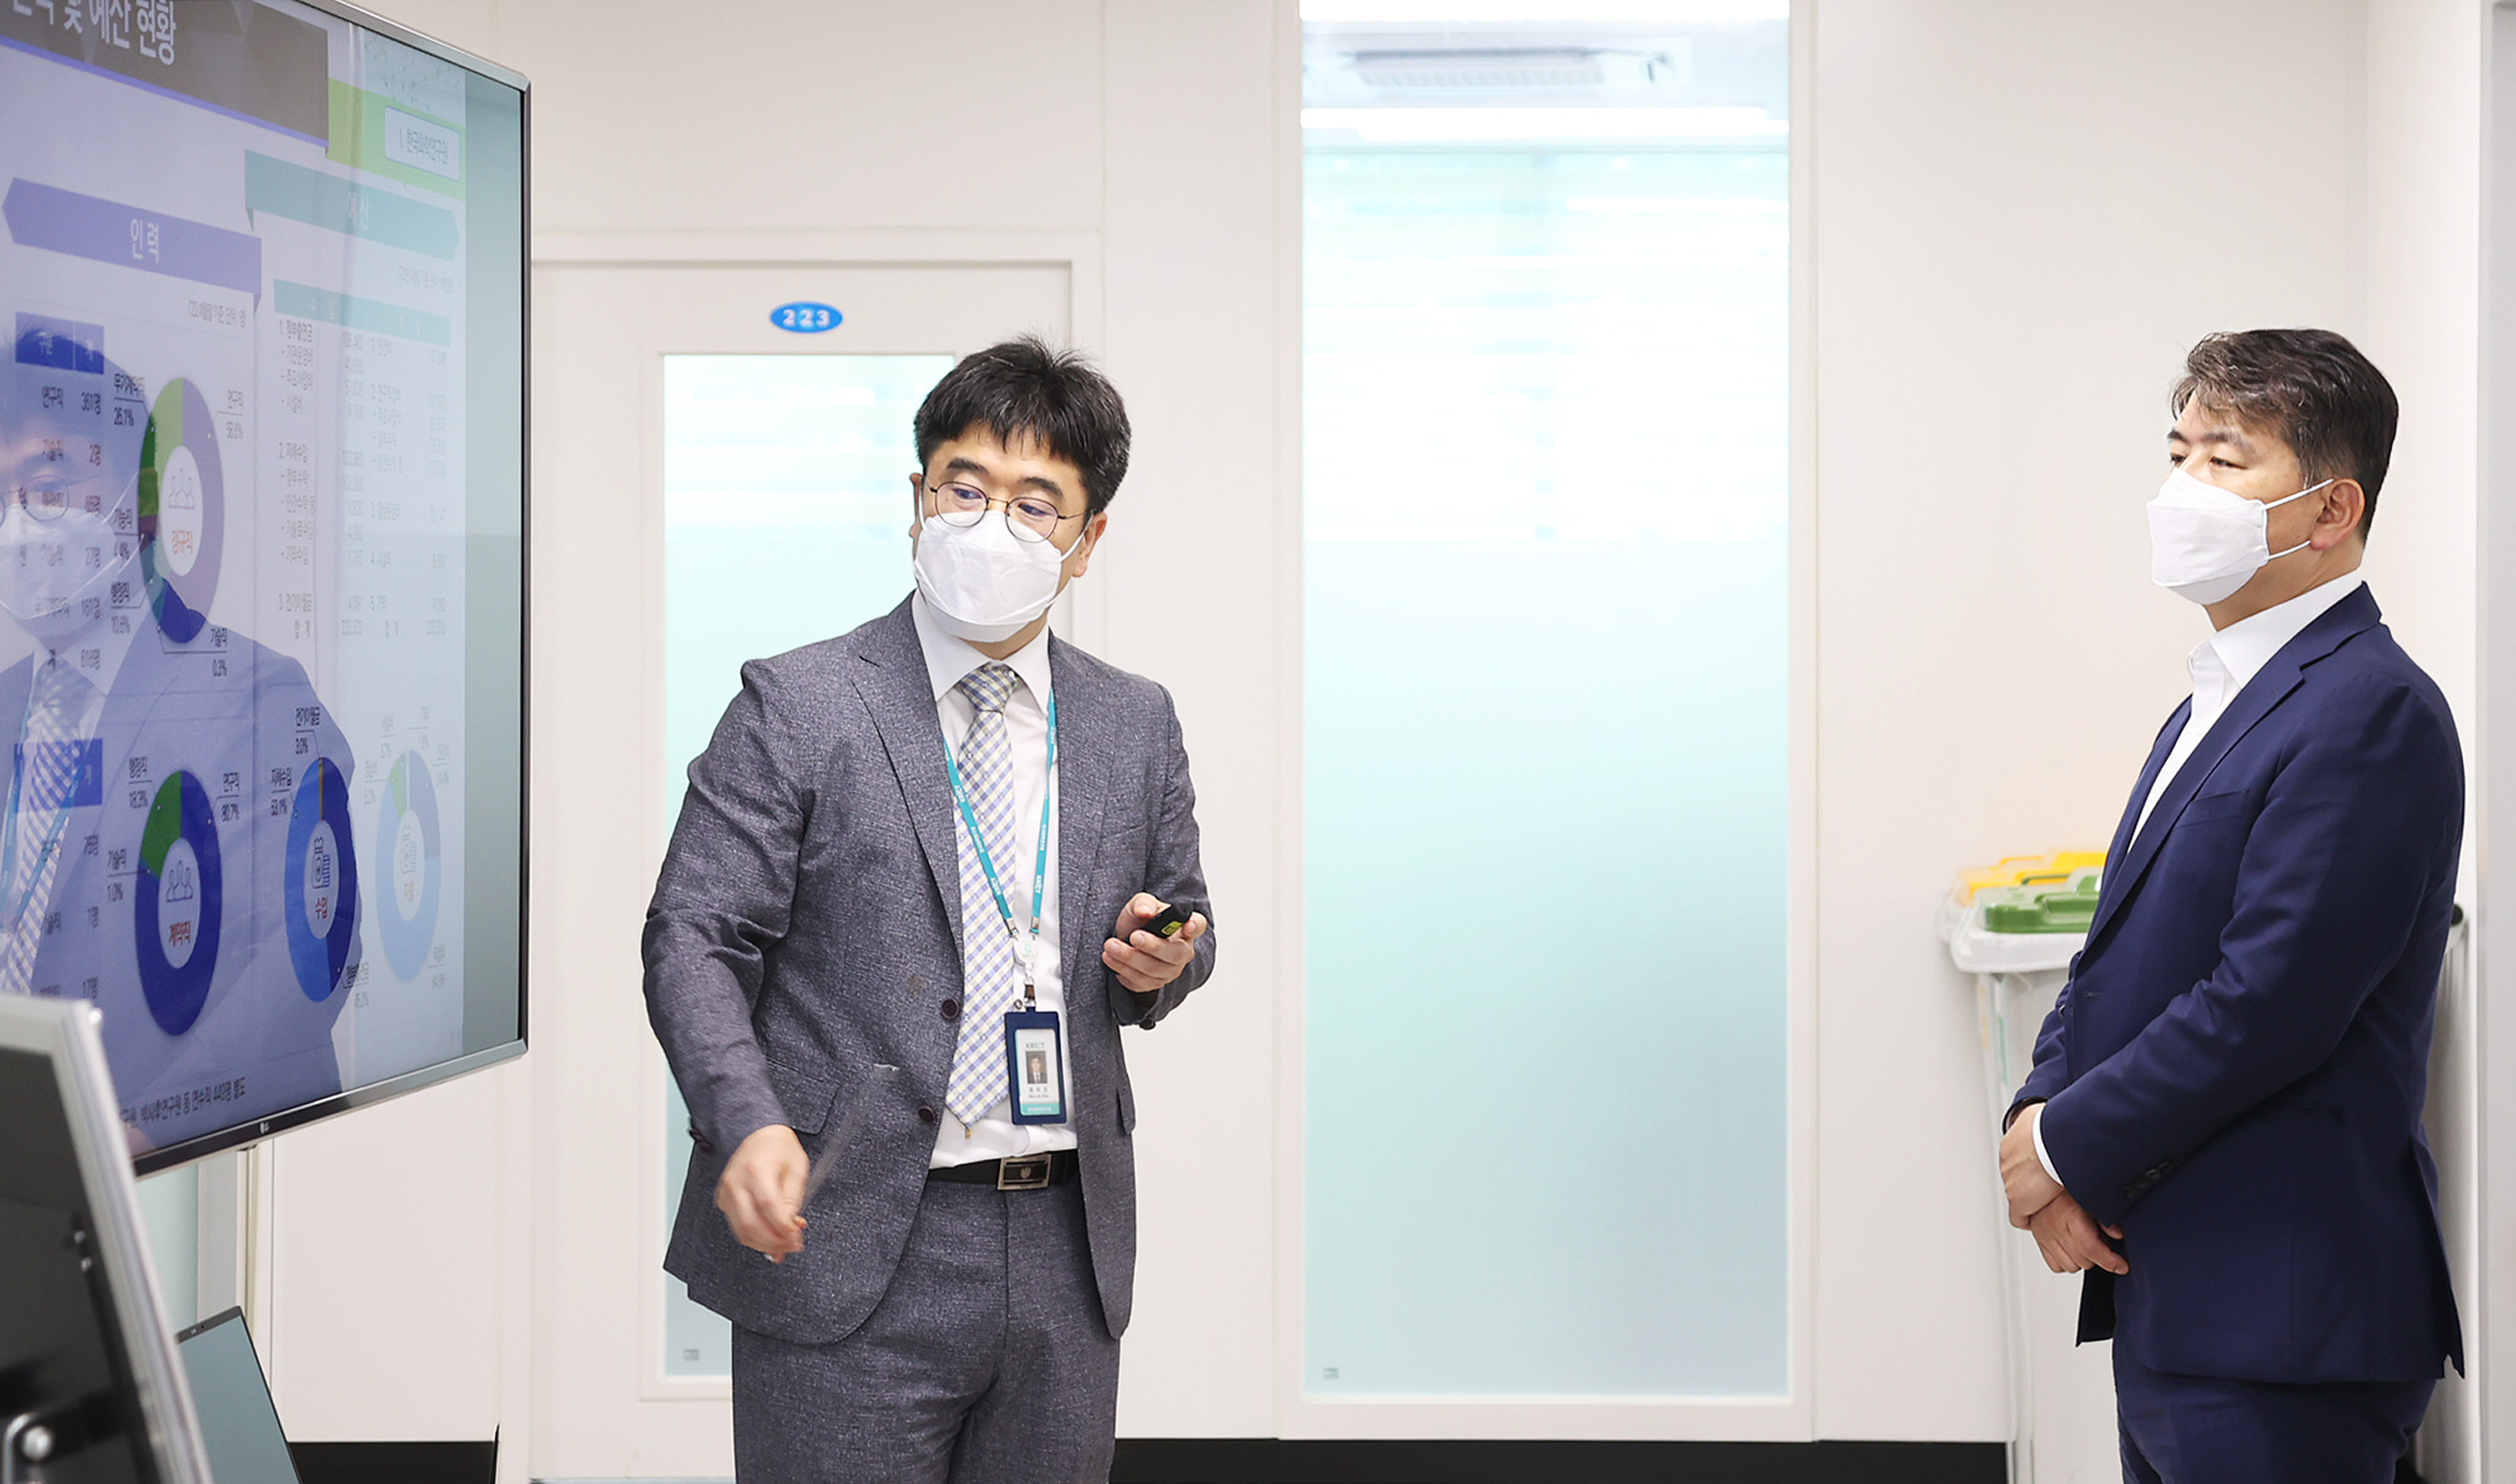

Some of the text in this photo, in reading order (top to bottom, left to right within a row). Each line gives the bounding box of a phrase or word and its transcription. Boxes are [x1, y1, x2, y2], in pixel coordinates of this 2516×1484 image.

[137, 0, 178, 65] 현황
[130, 217, 159, 265] 인력
[782, 309, 831, 328] 223
[171, 529, 194, 555] 정규직
[314, 895, 328, 920] 수입
